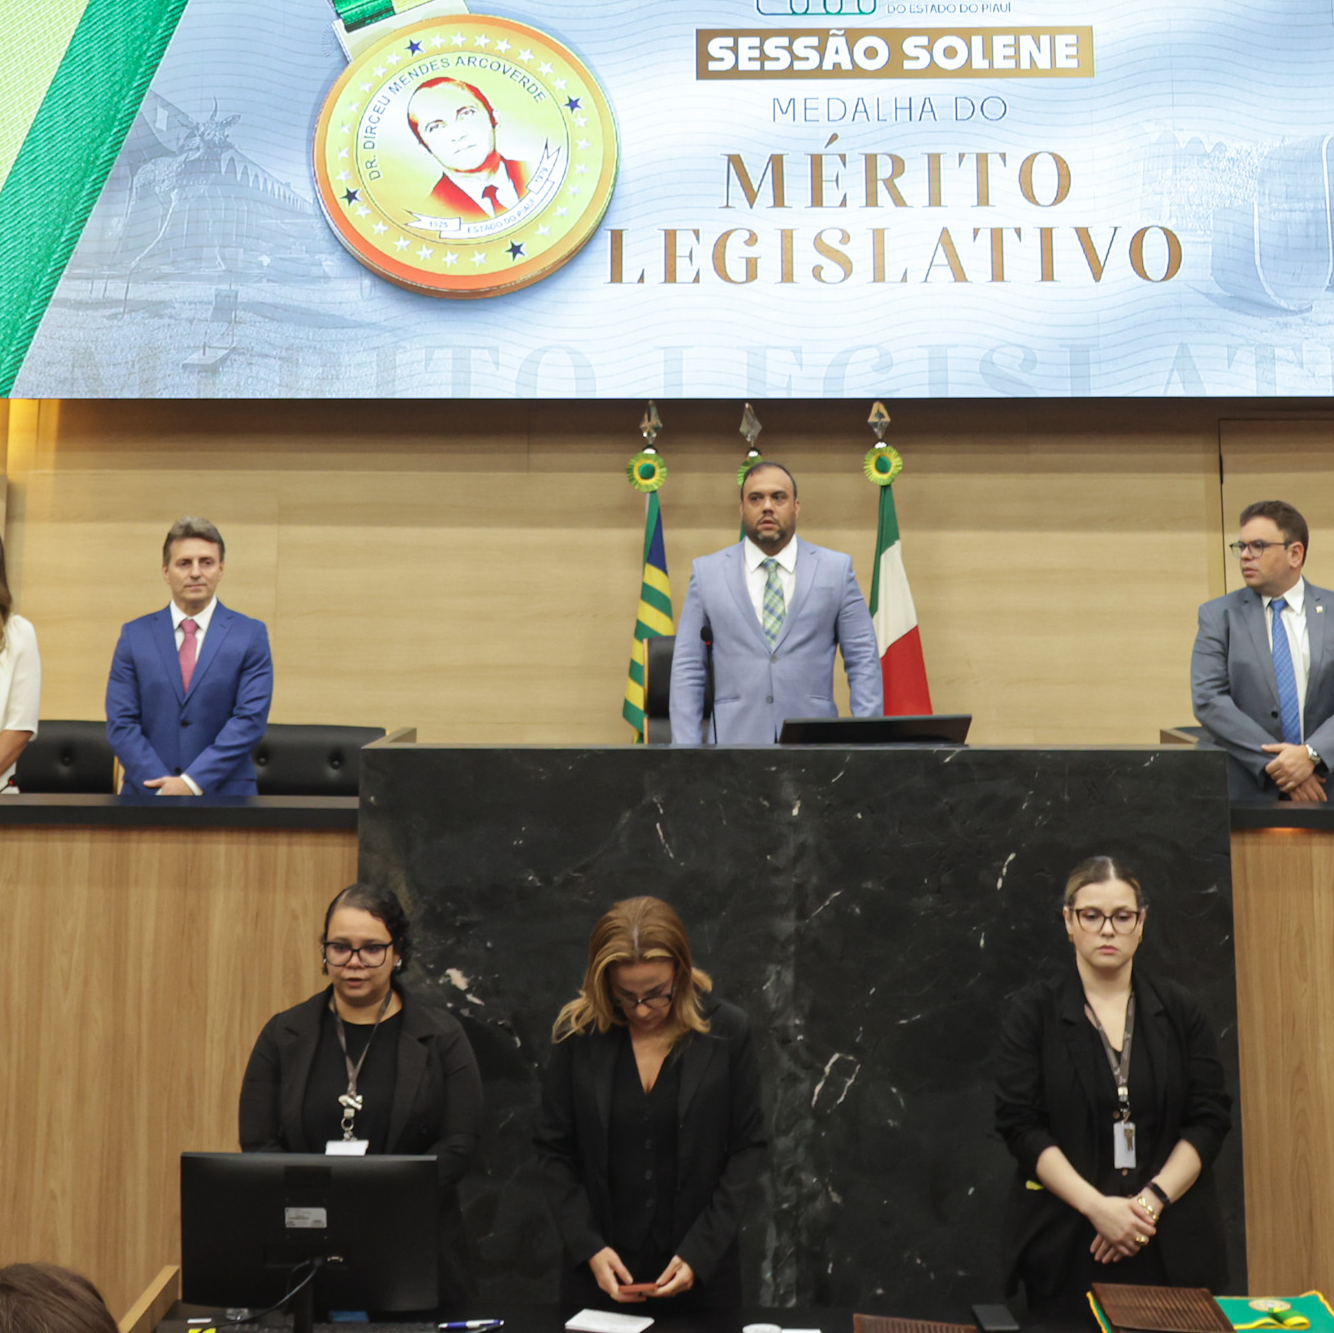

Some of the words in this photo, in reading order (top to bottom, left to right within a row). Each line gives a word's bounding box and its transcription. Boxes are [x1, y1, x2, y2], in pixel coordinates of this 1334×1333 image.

[887, 3, 906, 14] DO
[909, 3, 957, 14] ESTADO
[959, 3, 979, 13] DO
[706, 28, 891, 72] SESSÃO
[901, 33, 1080, 71] SOLENE
[388, 57, 451, 96] MENDES
[454, 55, 547, 104] ARCOVERDE
[362, 96, 392, 150] DIRCEU
[772, 95, 938, 123] MEDALHA
[953, 95, 1008, 122] DO
[364, 155, 381, 181] DR.
[718, 131, 1072, 211] MÉRITO
[466, 221, 503, 234] ESTADO
[503, 215, 517, 225] DO
[603, 223, 1183, 285] LEGISLATIVO
